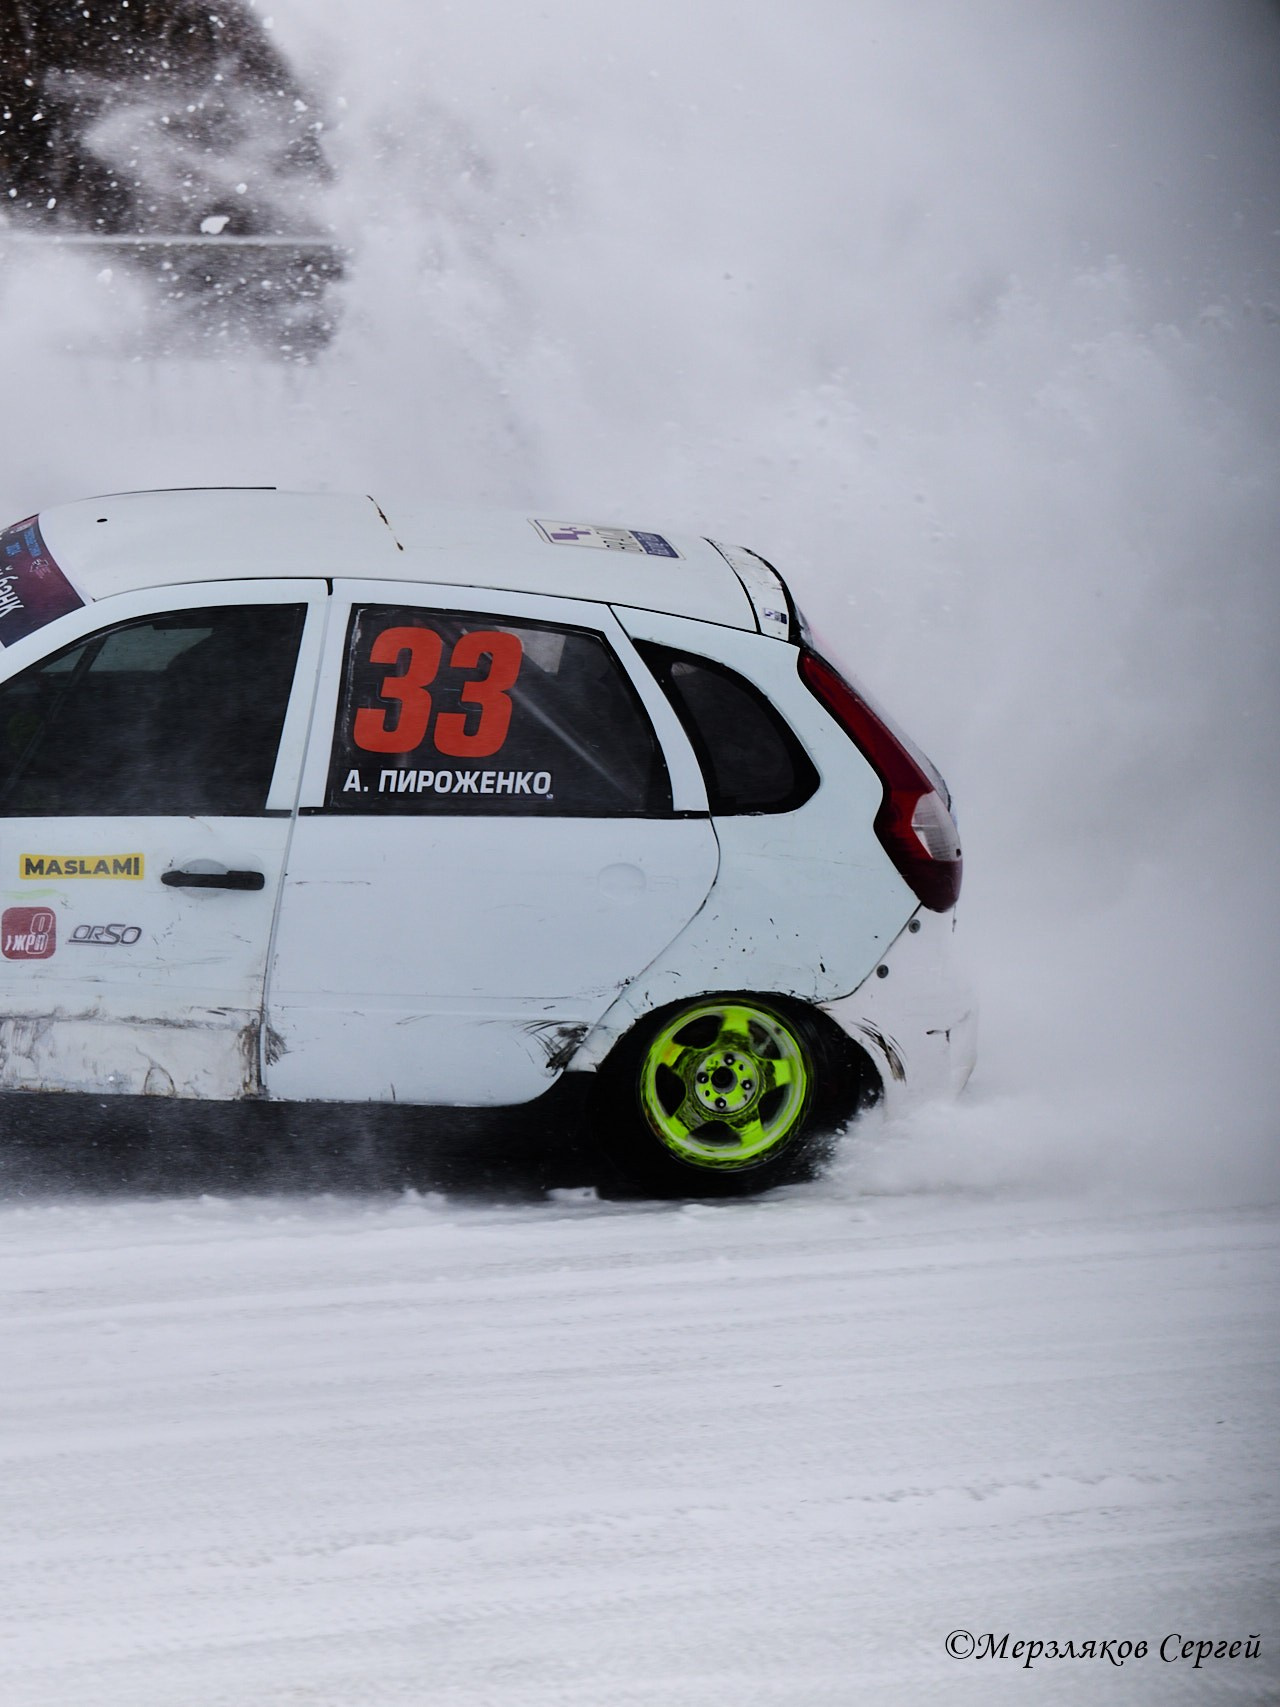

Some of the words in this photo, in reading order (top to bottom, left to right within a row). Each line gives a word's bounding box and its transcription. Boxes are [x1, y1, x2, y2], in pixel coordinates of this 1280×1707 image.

[353, 626, 523, 758] 33
[342, 769, 369, 792] А.
[378, 769, 552, 794] ПИРОЖЕНКО
[24, 857, 140, 876] MASLAMI
